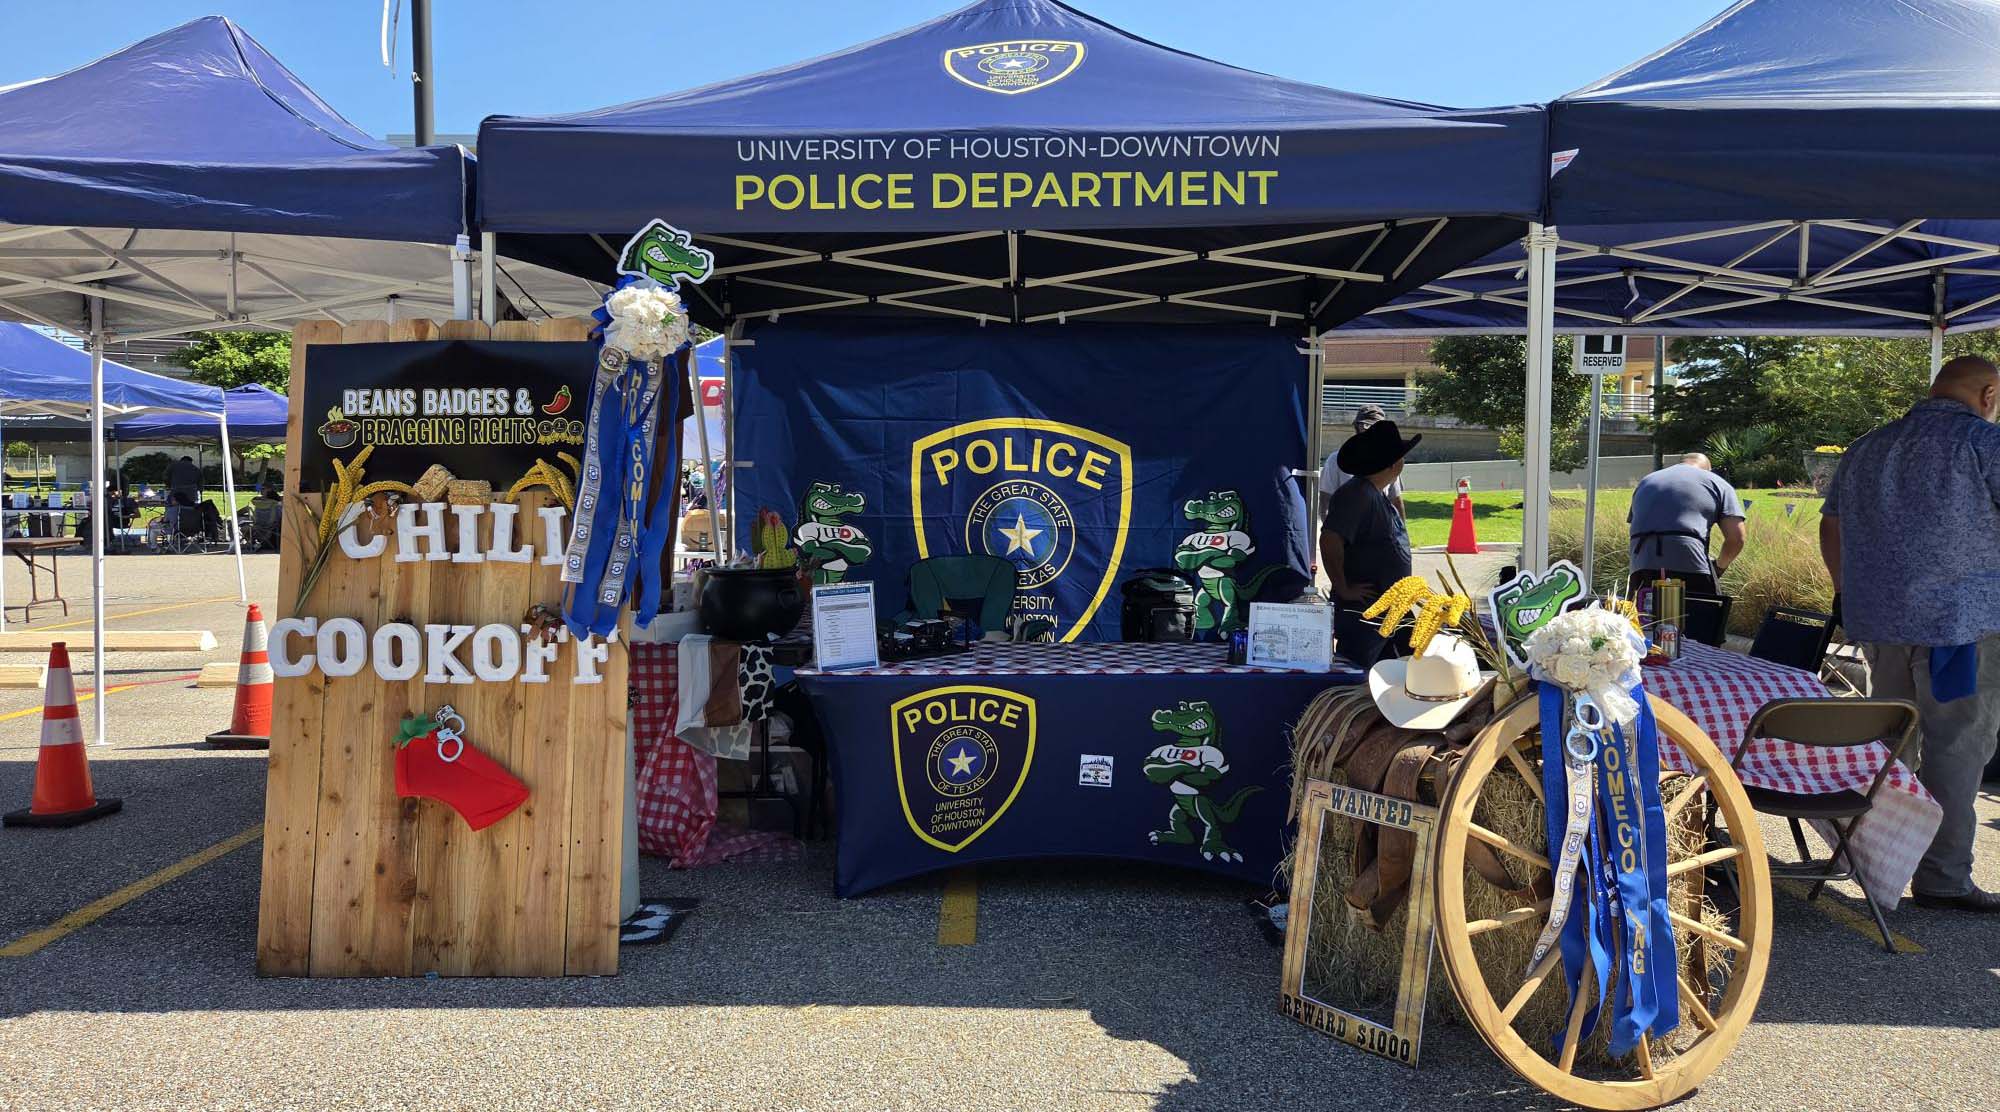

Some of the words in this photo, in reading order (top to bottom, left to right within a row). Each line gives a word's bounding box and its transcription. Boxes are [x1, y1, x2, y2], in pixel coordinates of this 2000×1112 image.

[957, 43, 1070, 58] POLICE
[737, 139, 896, 162] UNIVERSITY
[903, 138, 942, 160] OF
[949, 134, 1281, 159] HOUSTON-DOWNTOWN
[735, 172, 915, 210] POLICE
[932, 170, 1278, 209] DEPARTMENT
[1583, 356, 1622, 367] RESERVED
[343, 388, 416, 416] BEANS
[422, 388, 509, 416] BADGES
[515, 388, 533, 415] &
[362, 418, 465, 446] BRAGGING
[469, 417, 537, 445] RIGHTS
[931, 437, 1112, 490] POLICE
[973, 500, 992, 525] THE
[991, 485, 1038, 500] GREAT
[1039, 492, 1069, 527] STATE
[337, 501, 575, 565] CHILI
[1019, 563, 1056, 585] EXAS
[1013, 596, 1055, 610] ERSITY
[267, 616, 617, 684] COOKOFF
[903, 698, 1022, 734] POLICE
[931, 740, 945, 759] THE
[943, 728, 973, 742] GREAT
[974, 731, 994, 755] STATE
[937, 781, 950, 793] OF
[953, 776, 985, 794] TEXAS
[931, 814, 943, 824] OF
[944, 808, 985, 821] HOUSTON
[935, 797, 983, 812] UNIVERSITY
[1331, 787, 1412, 828] WANTED
[931, 818, 983, 834] DOWNTOWN
[1282, 993, 1346, 1038] REWARD
[1356, 1024, 1411, 1062] $1000
